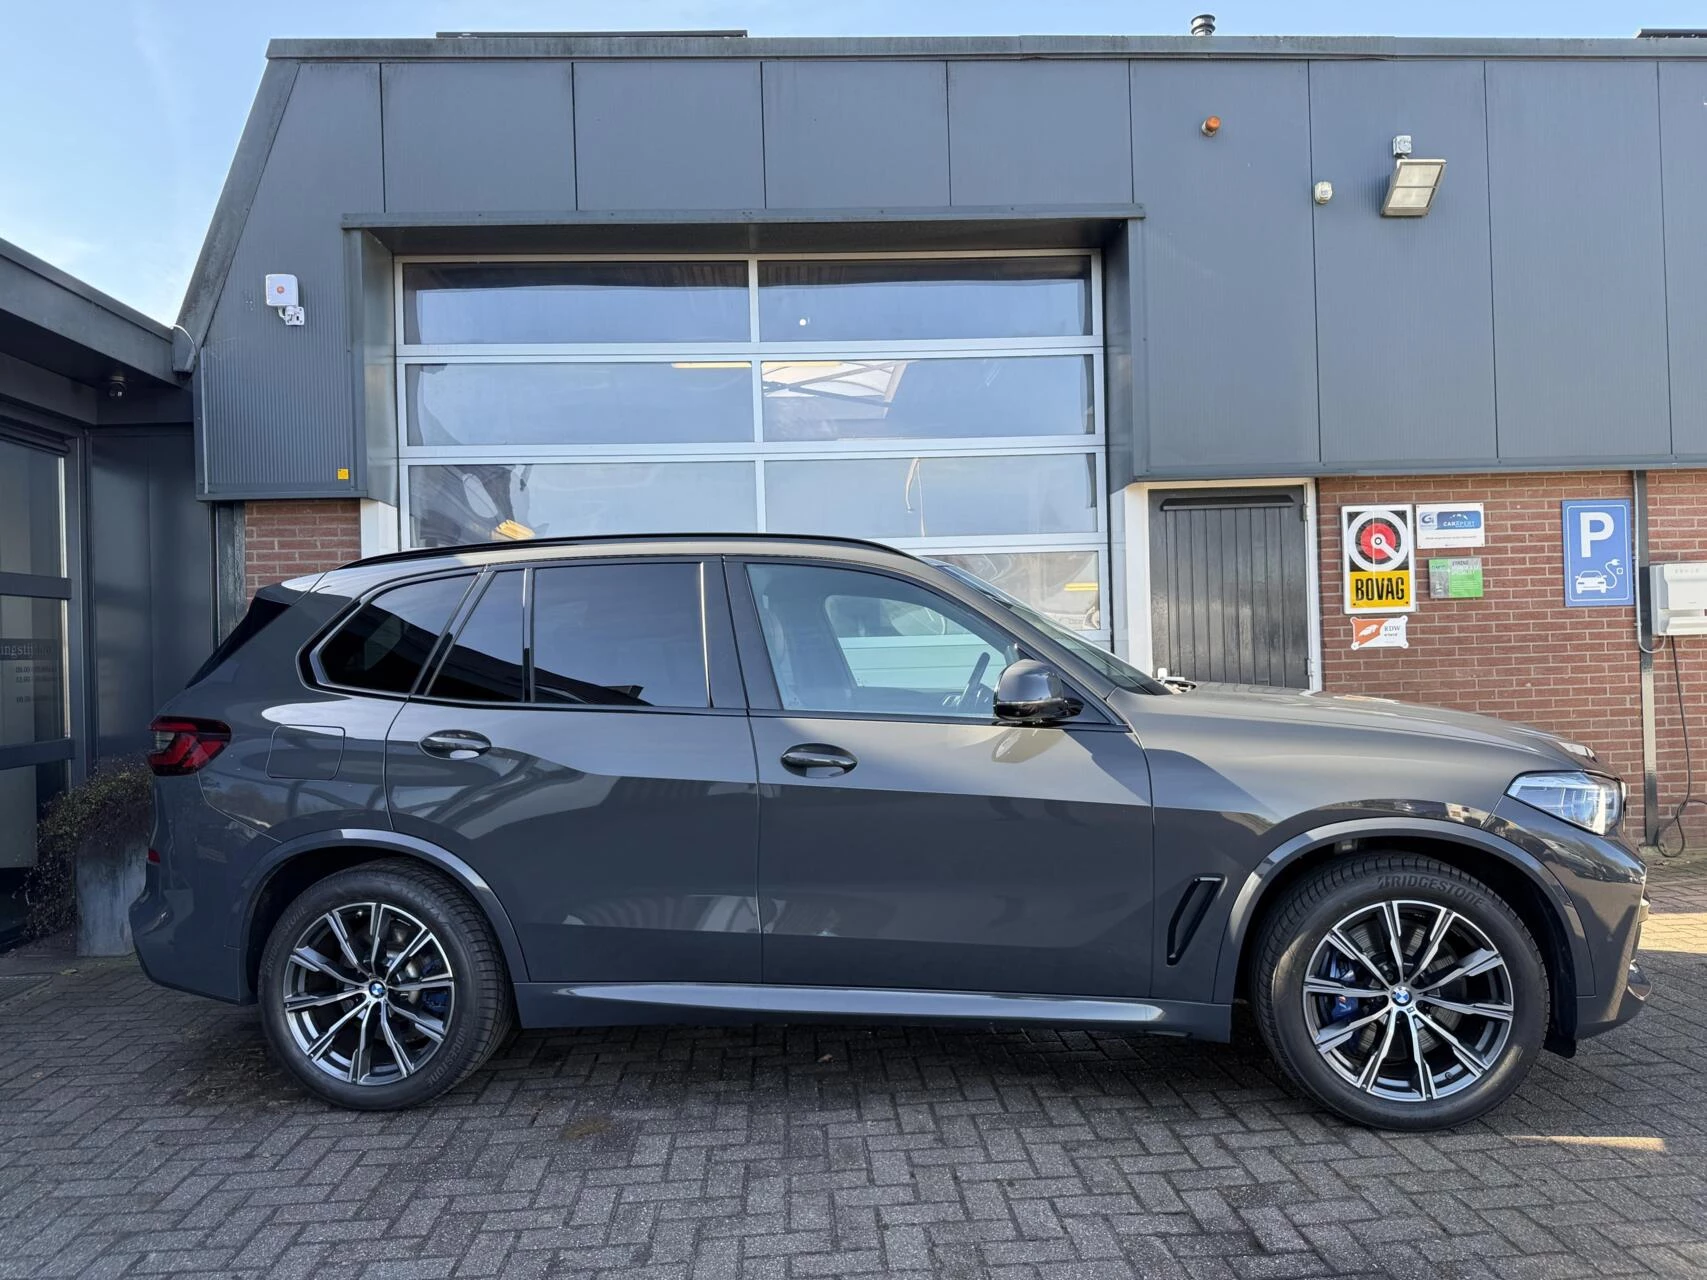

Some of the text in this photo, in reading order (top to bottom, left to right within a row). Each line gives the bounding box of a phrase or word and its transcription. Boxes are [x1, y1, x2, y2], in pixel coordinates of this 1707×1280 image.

[1579, 511, 1615, 558] P
[1355, 577, 1405, 602] BOVAG
[1377, 875, 1484, 906] BRIDGESTONE
